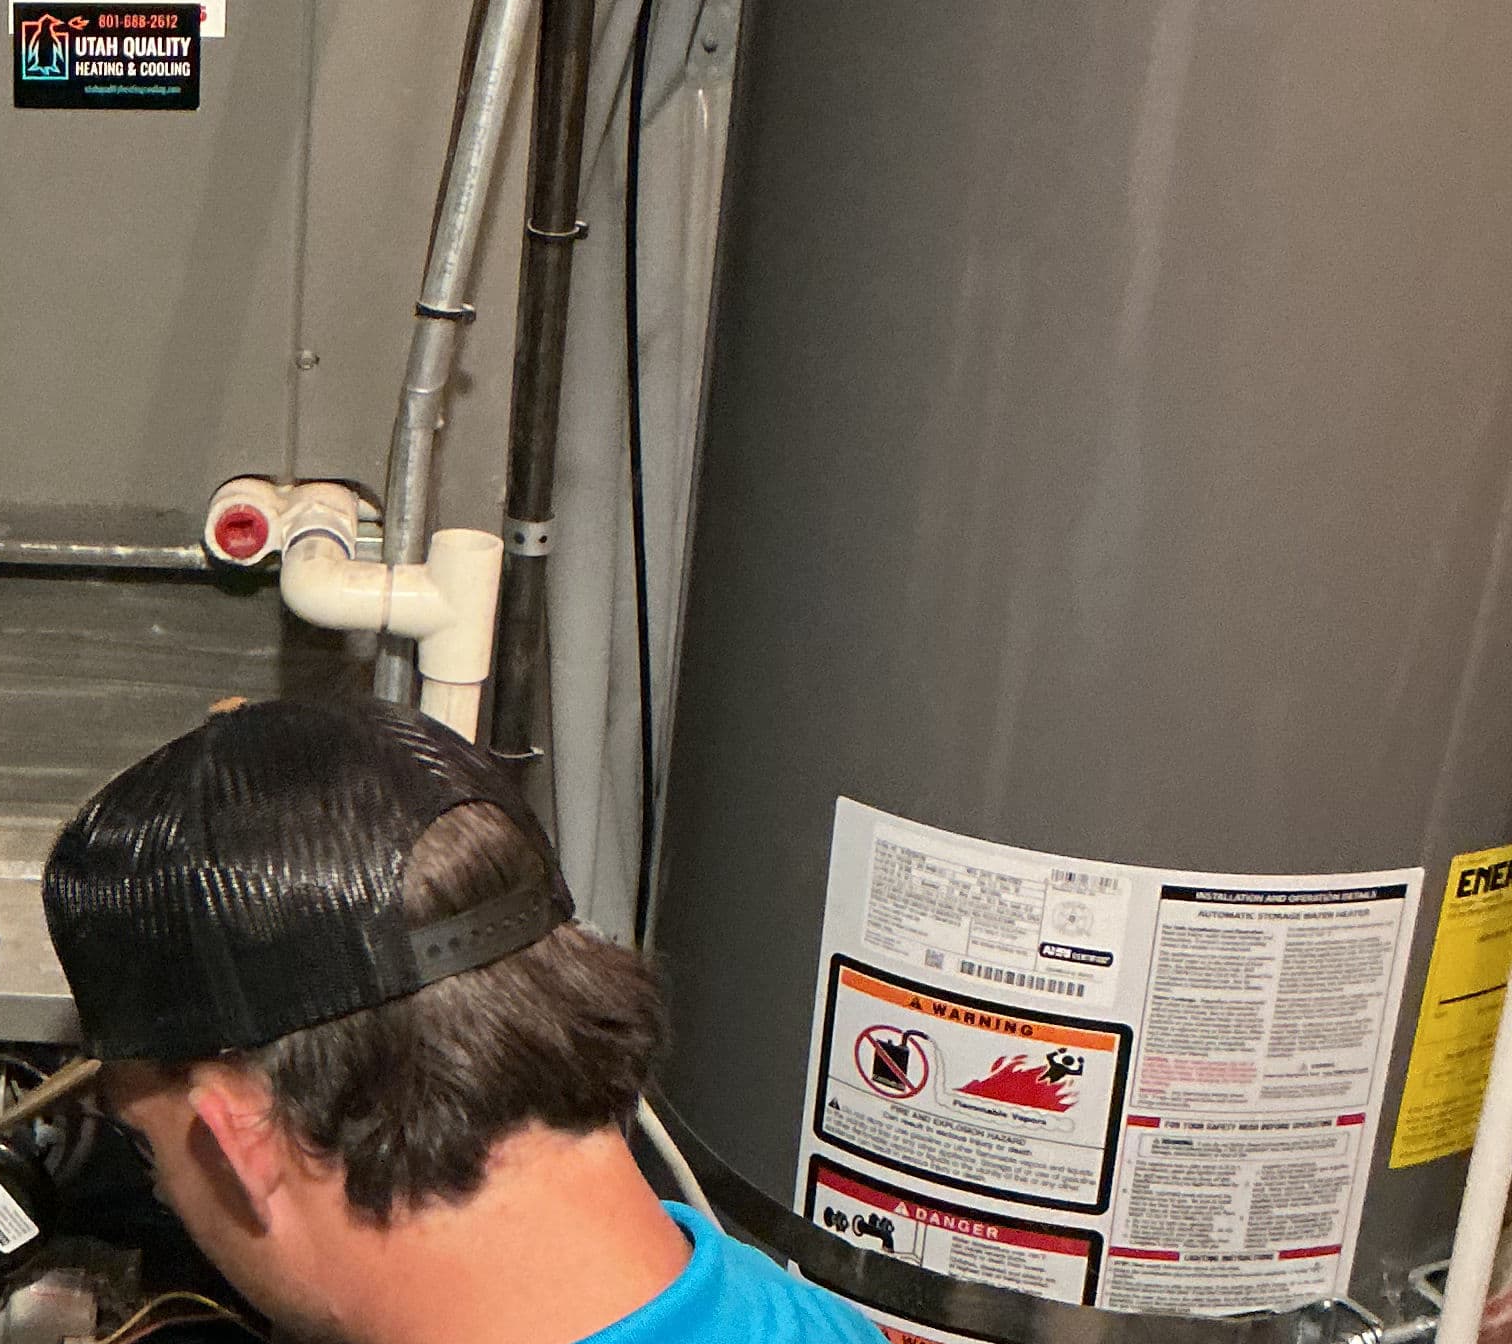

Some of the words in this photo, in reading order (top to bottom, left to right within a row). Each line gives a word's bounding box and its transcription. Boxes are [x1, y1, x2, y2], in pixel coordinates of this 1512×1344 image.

[74, 36, 119, 57] UTAH
[123, 36, 192, 59] QUALITY
[75, 61, 124, 77] HEATING
[127, 62, 137, 77] &
[140, 61, 191, 77] COOLING
[1456, 859, 1512, 899] ENE
[932, 1002, 1034, 1037] WARNING
[915, 1206, 1000, 1240] DANGER
